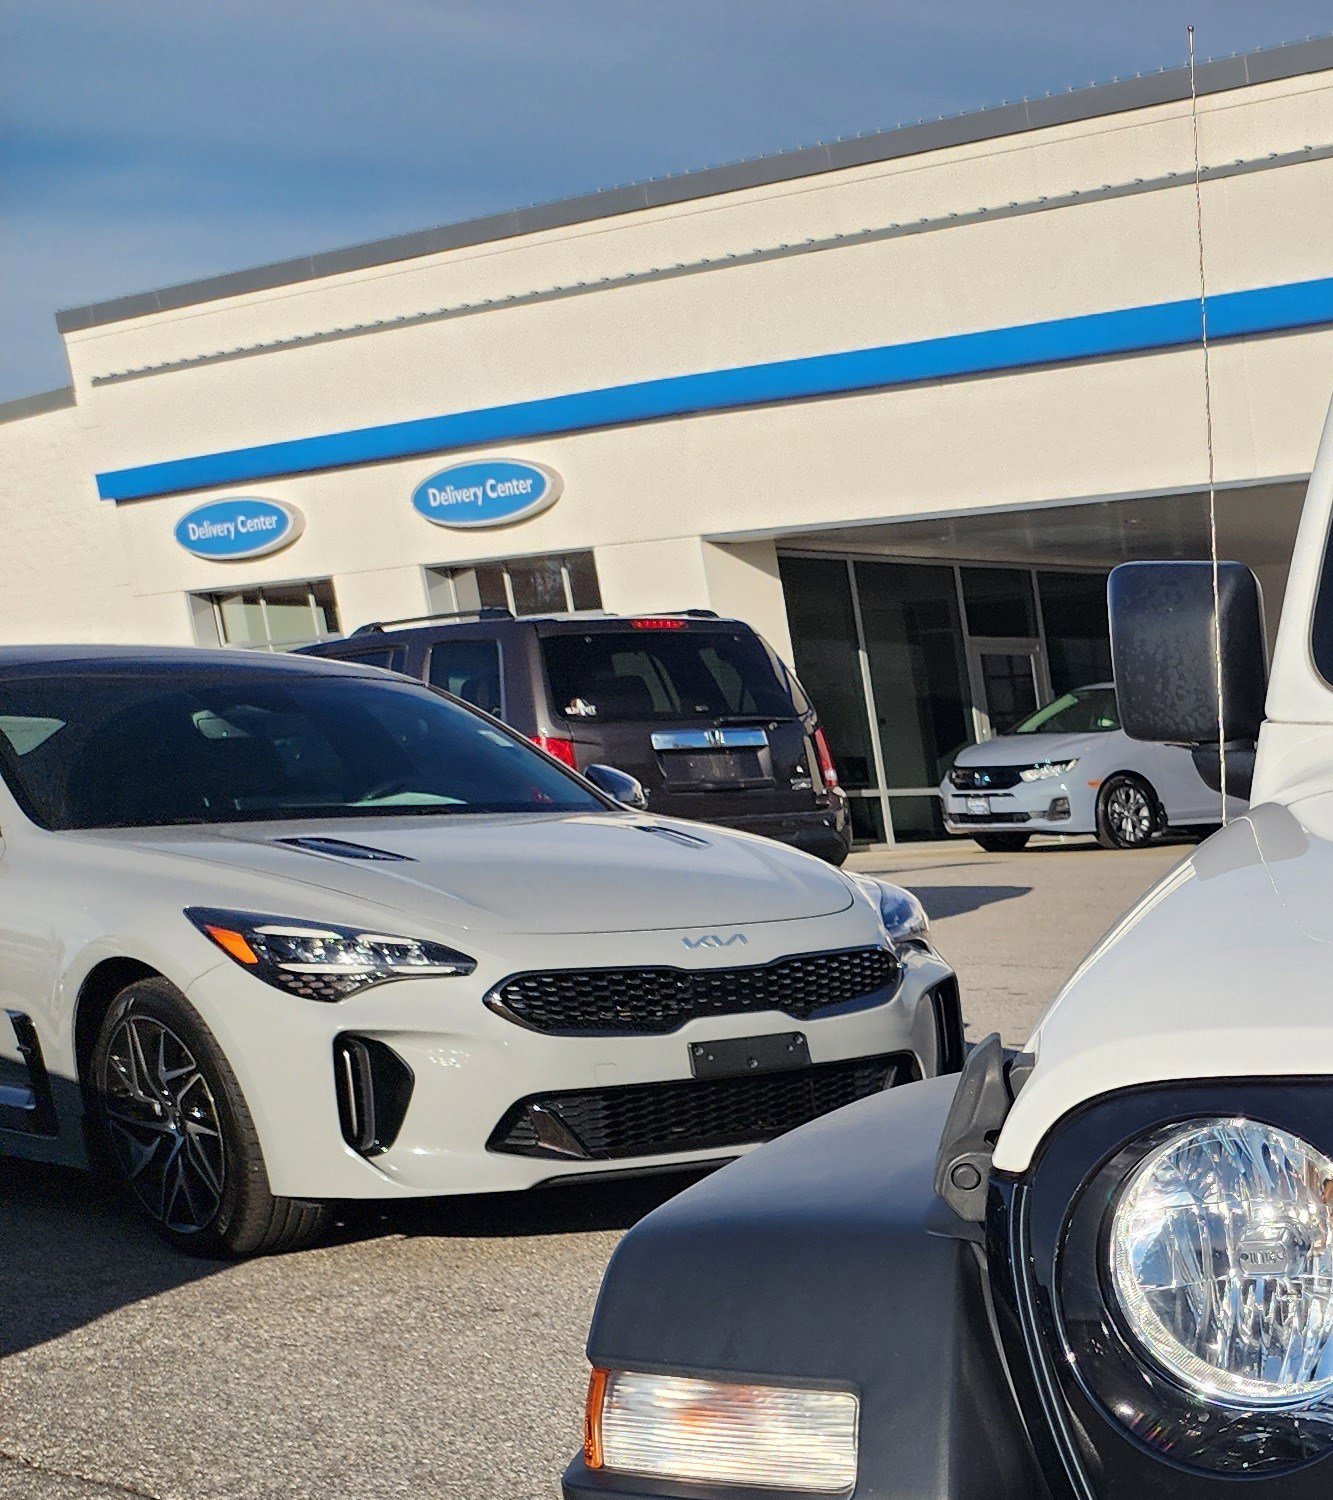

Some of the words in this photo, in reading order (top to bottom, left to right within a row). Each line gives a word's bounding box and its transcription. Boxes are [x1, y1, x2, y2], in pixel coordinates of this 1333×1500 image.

[427, 484, 483, 507] Delivery
[485, 477, 534, 497] Center
[187, 520, 236, 541] Delivery
[236, 513, 278, 534] Center
